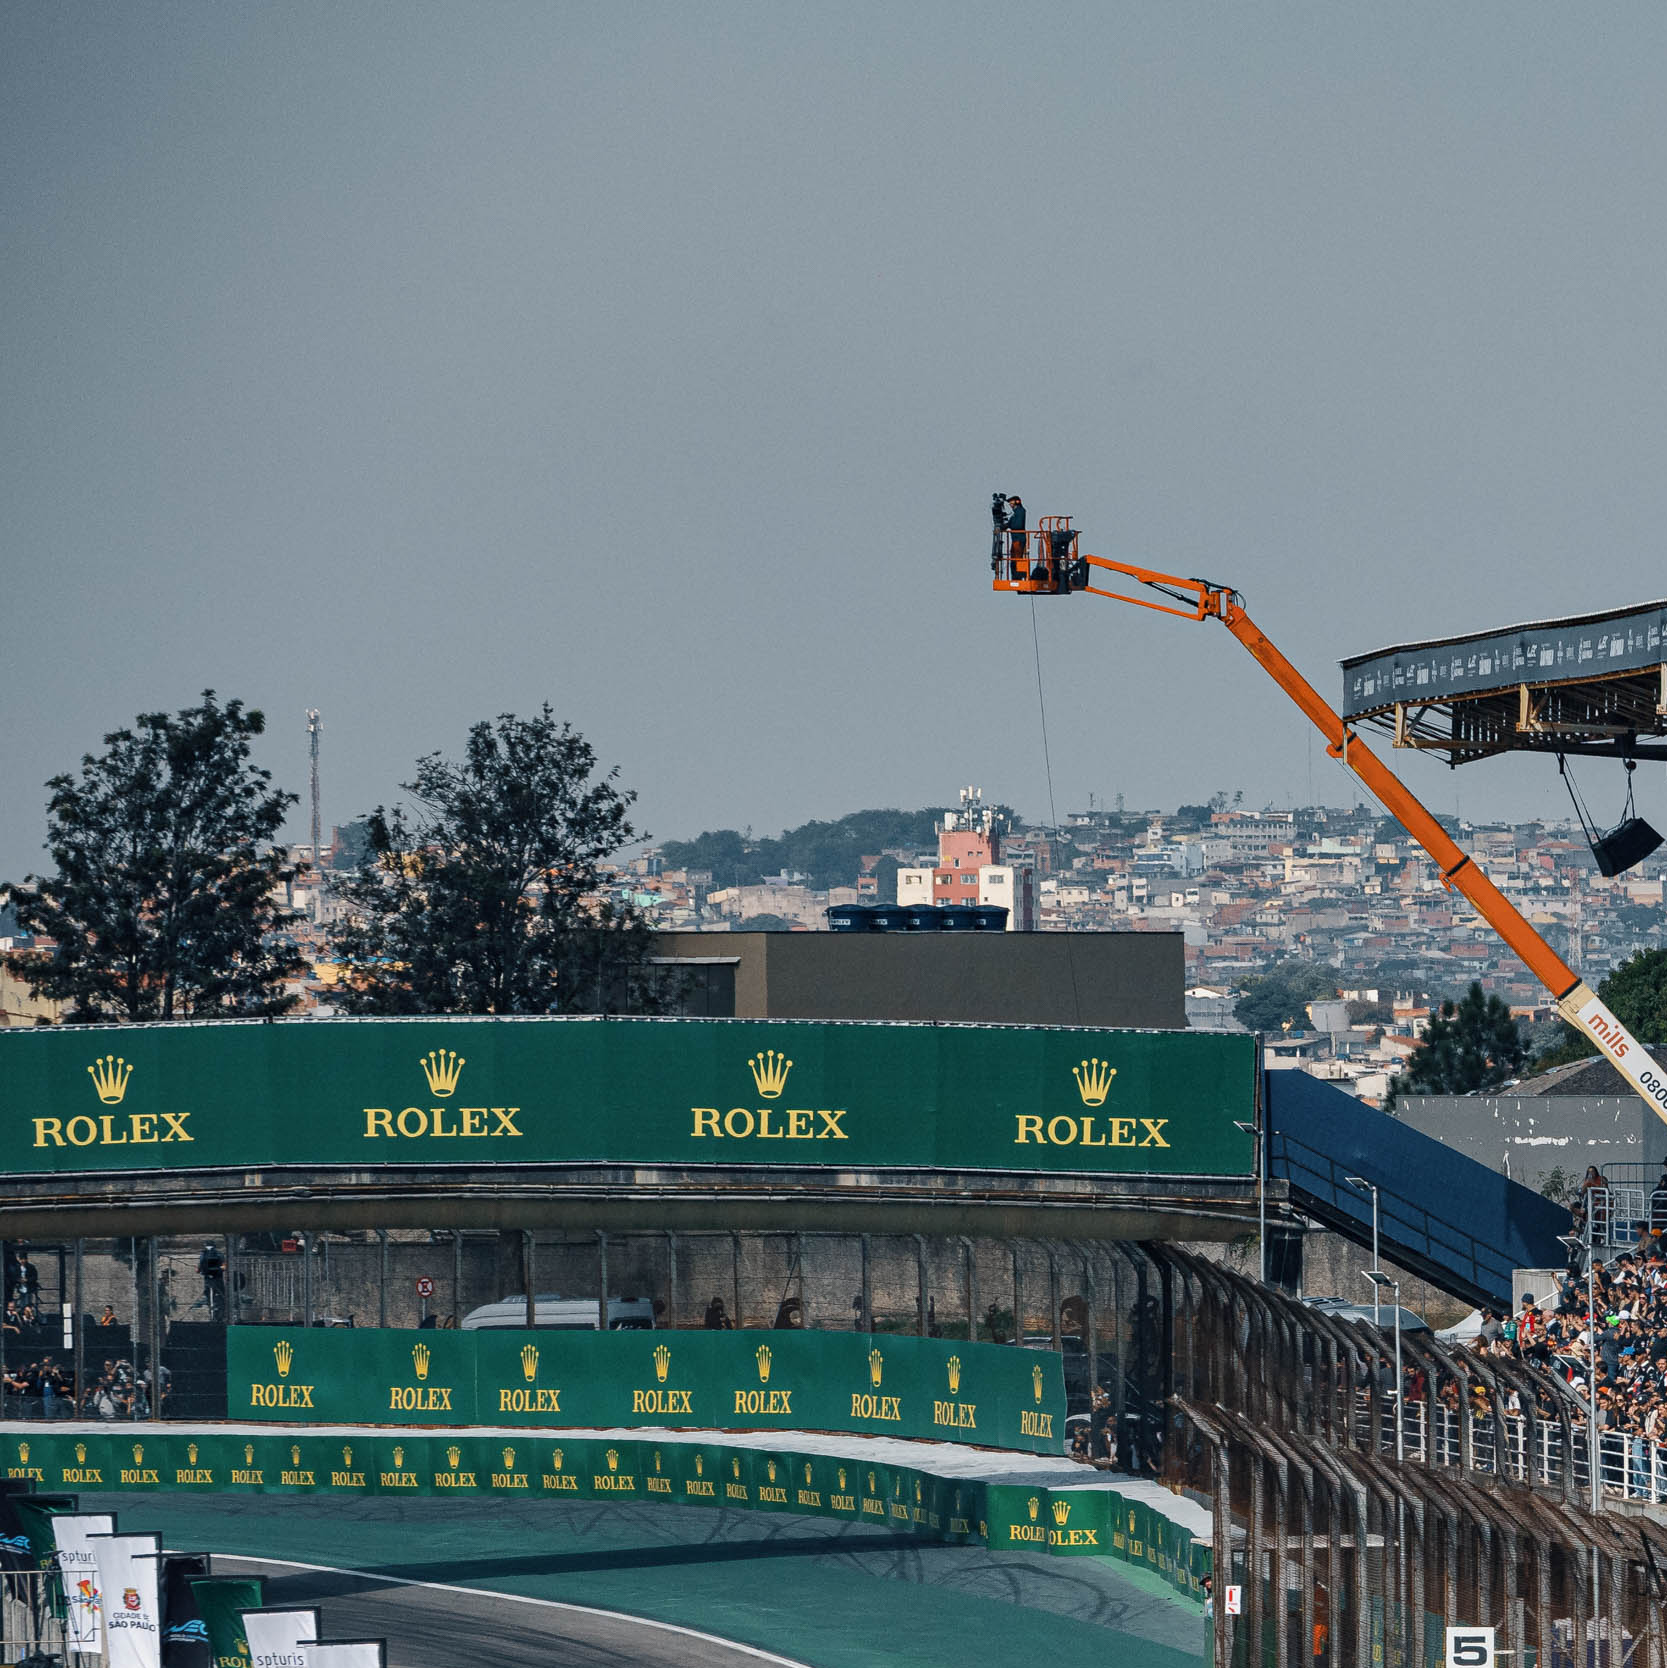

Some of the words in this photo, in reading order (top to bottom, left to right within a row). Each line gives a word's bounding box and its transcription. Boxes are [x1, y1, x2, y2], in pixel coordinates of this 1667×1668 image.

[1588, 1013, 1630, 1058] mills
[1072, 1058, 1117, 1106] ROLEX
[32, 1112, 194, 1147] ROLEX
[363, 1108, 523, 1137] ROLEX
[691, 1108, 848, 1138] ROLEX
[251, 1384, 314, 1408] ROLEX
[390, 1387, 451, 1410] ROLEX
[499, 1389, 560, 1412] ROLEX
[633, 1390, 692, 1413] ROLEX
[735, 1391, 792, 1414] ROLEX
[851, 1394, 901, 1420] ROLEX
[934, 1400, 976, 1428] ROLEX
[1022, 1411, 1052, 1438] ROLEX
[435, 1473, 477, 1487] ROLEX
[594, 1476, 635, 1490] ROLEX
[760, 1487, 787, 1502] ROLEX
[1010, 1524, 1046, 1542] ROLE
[1048, 1529, 1099, 1546] OLEX
[256, 1652, 304, 1668] spturis
